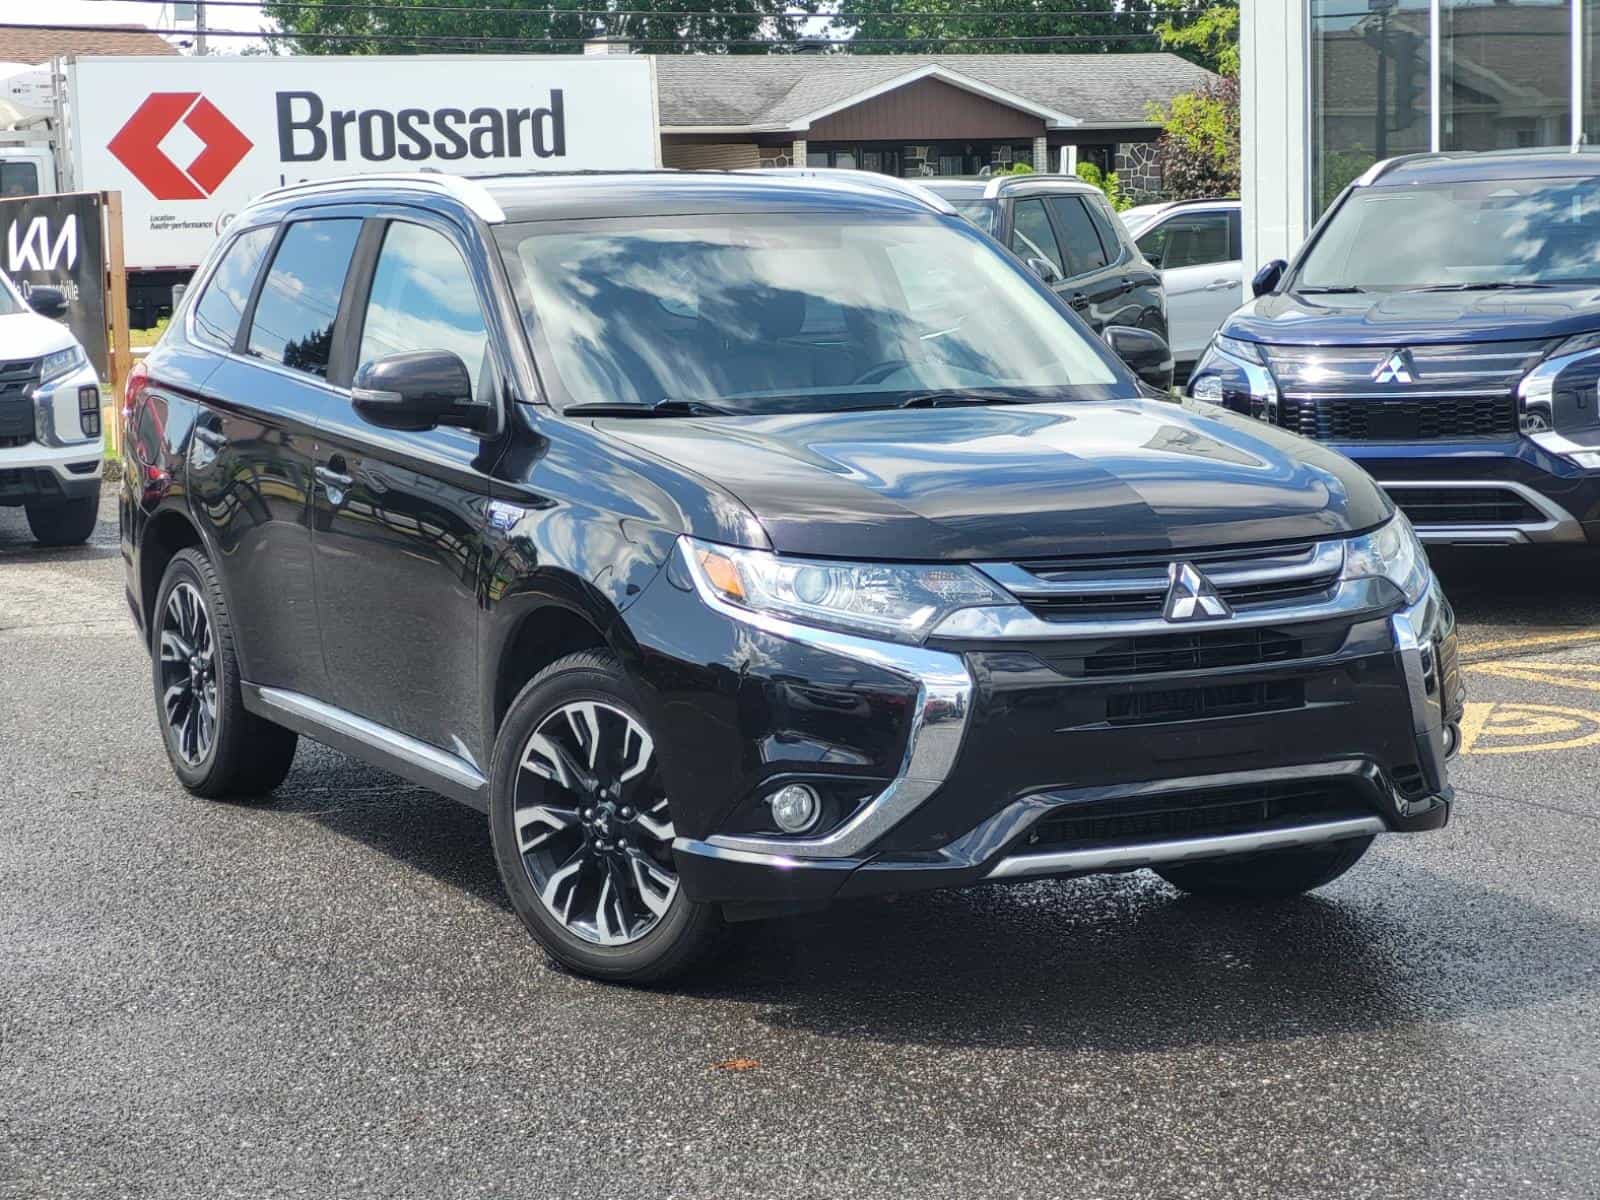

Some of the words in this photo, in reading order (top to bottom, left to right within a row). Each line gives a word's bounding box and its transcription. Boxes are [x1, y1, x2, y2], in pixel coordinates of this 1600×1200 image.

[275, 88, 566, 162] Brossard
[8, 213, 77, 272] KIA
[150, 214, 175, 222] Location
